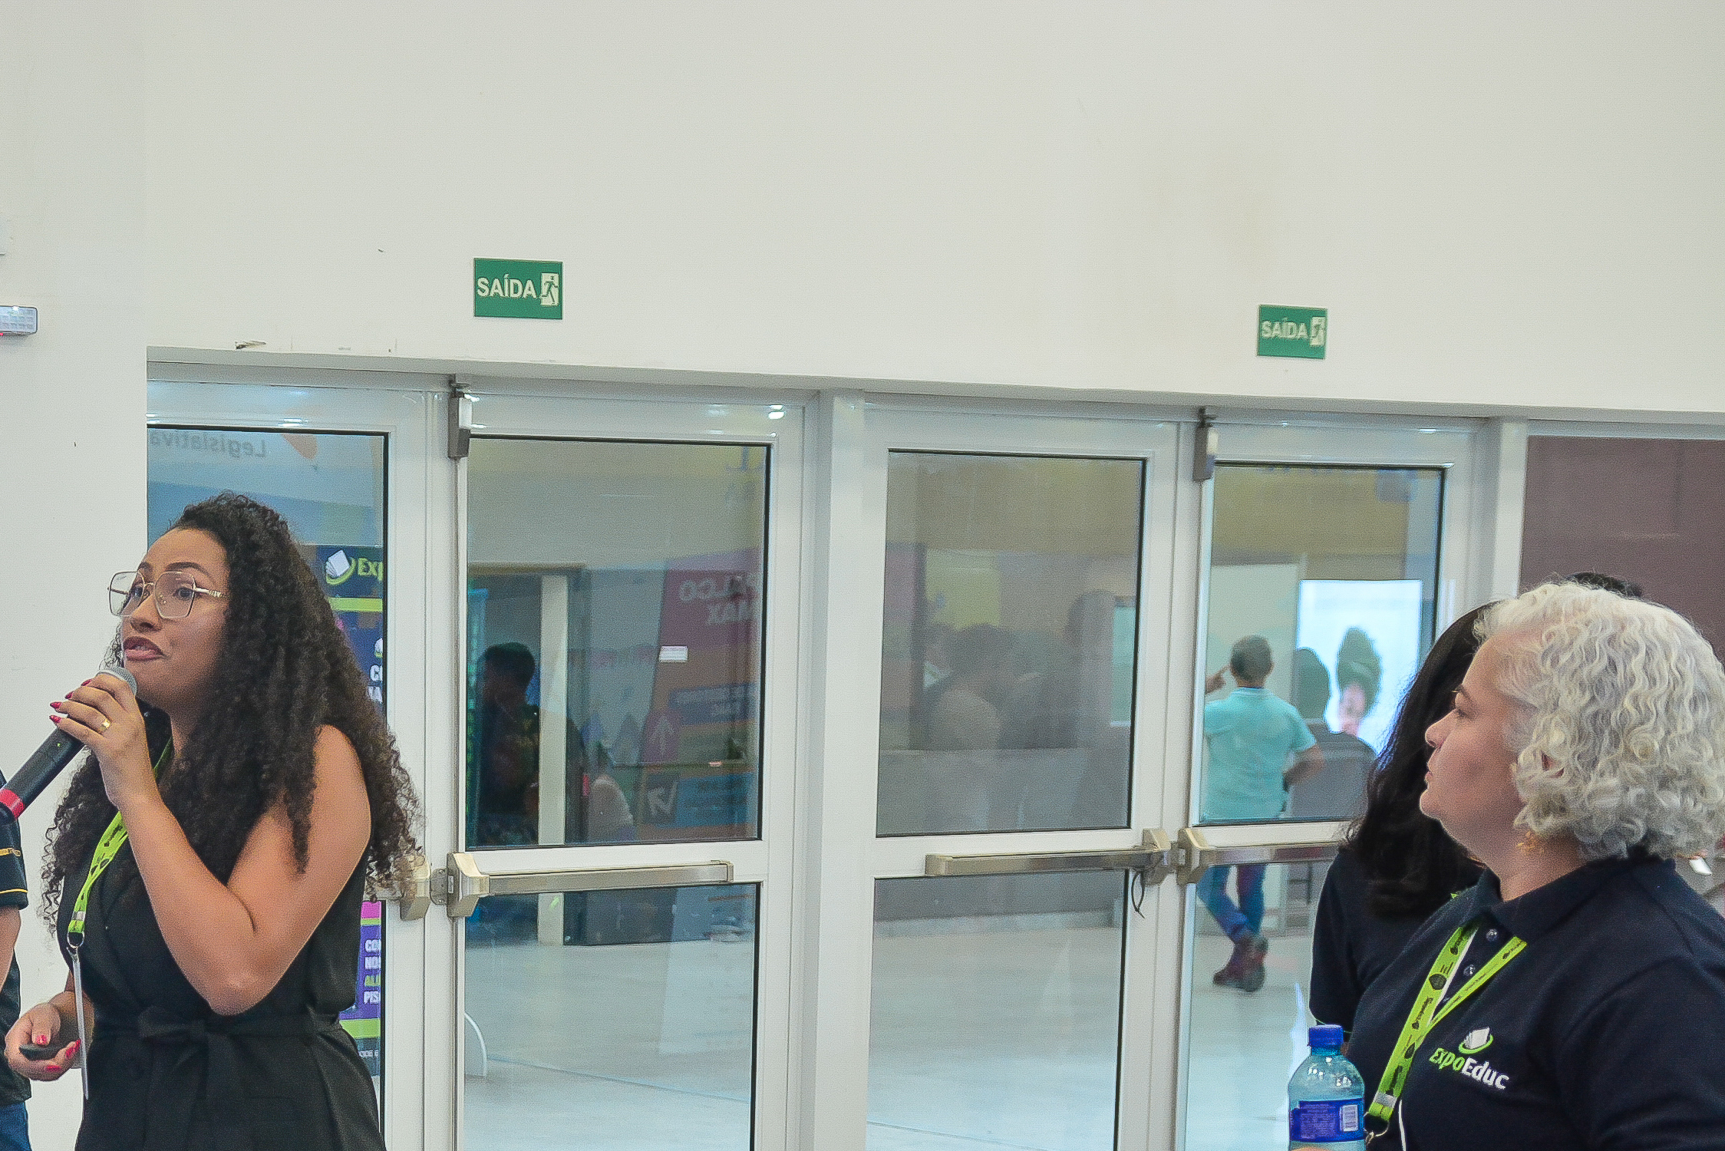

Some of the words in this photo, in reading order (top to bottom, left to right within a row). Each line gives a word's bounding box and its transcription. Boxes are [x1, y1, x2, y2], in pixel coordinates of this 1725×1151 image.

[477, 273, 537, 299] SAÍDA
[1261, 317, 1309, 340] SAÍDA
[1429, 1047, 1510, 1090] ExpoEduc
